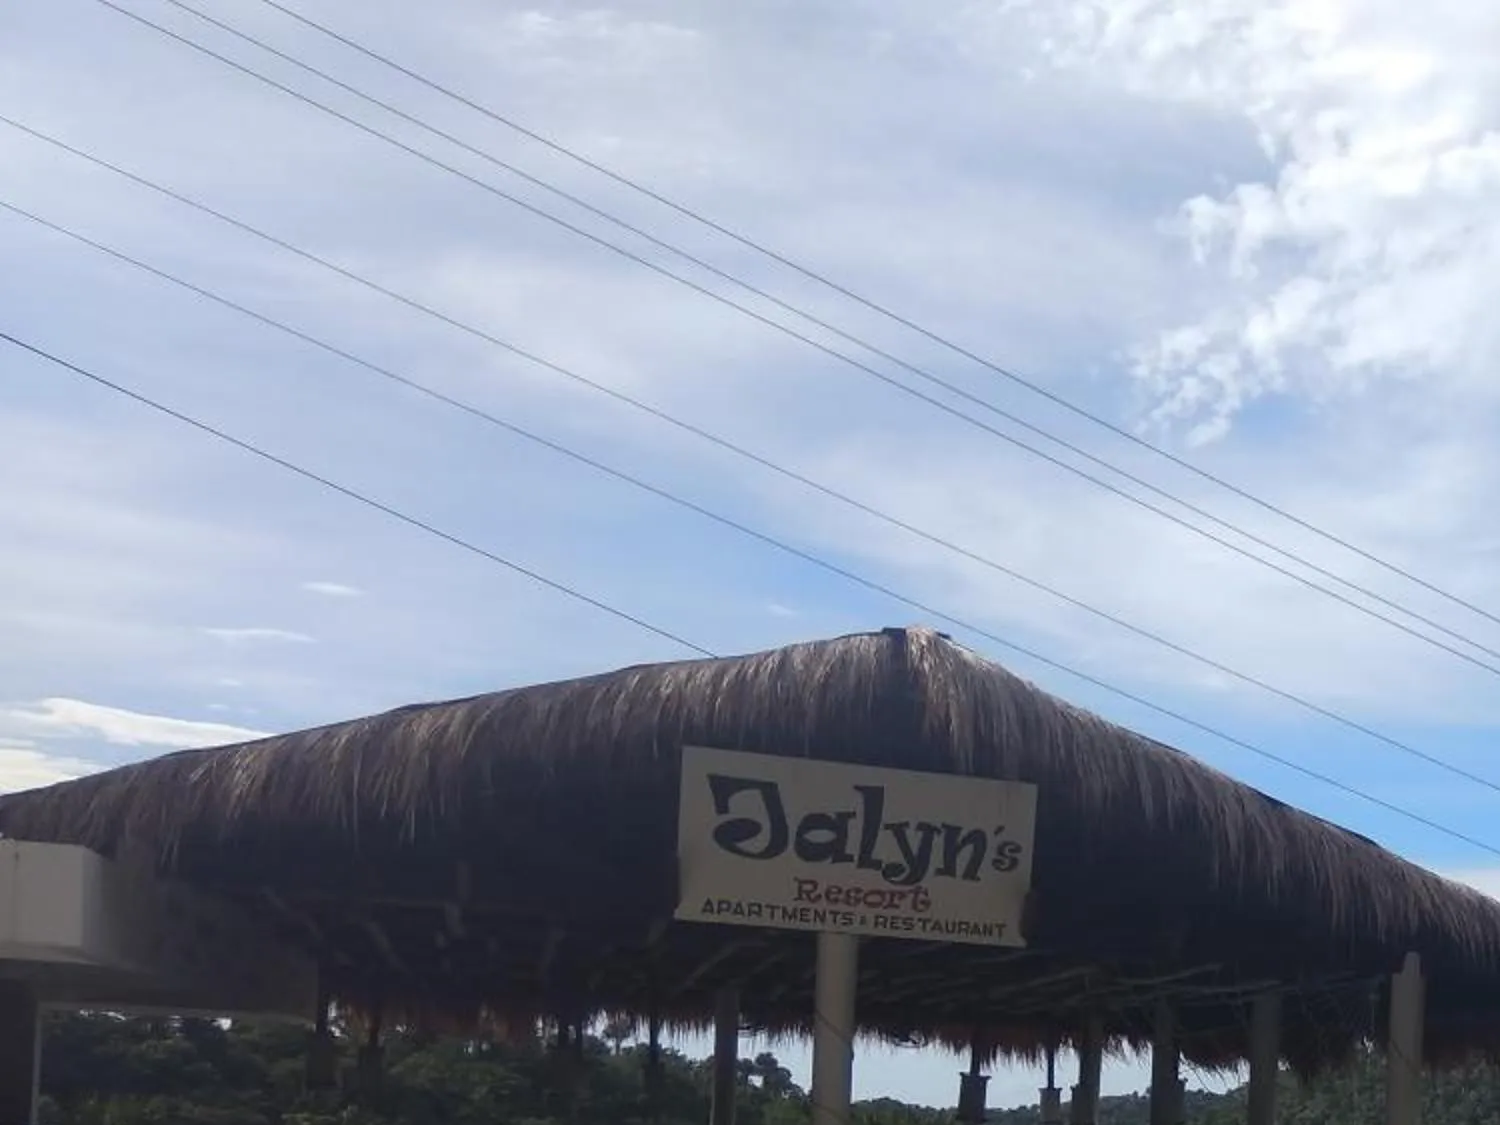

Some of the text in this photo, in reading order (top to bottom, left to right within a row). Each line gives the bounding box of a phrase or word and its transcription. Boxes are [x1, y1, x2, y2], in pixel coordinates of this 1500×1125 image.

[706, 774, 1023, 886] Jalyn's
[793, 877, 931, 912] Resort
[701, 898, 856, 926] APARTMENTS
[873, 914, 1008, 938] RESTAURANT
